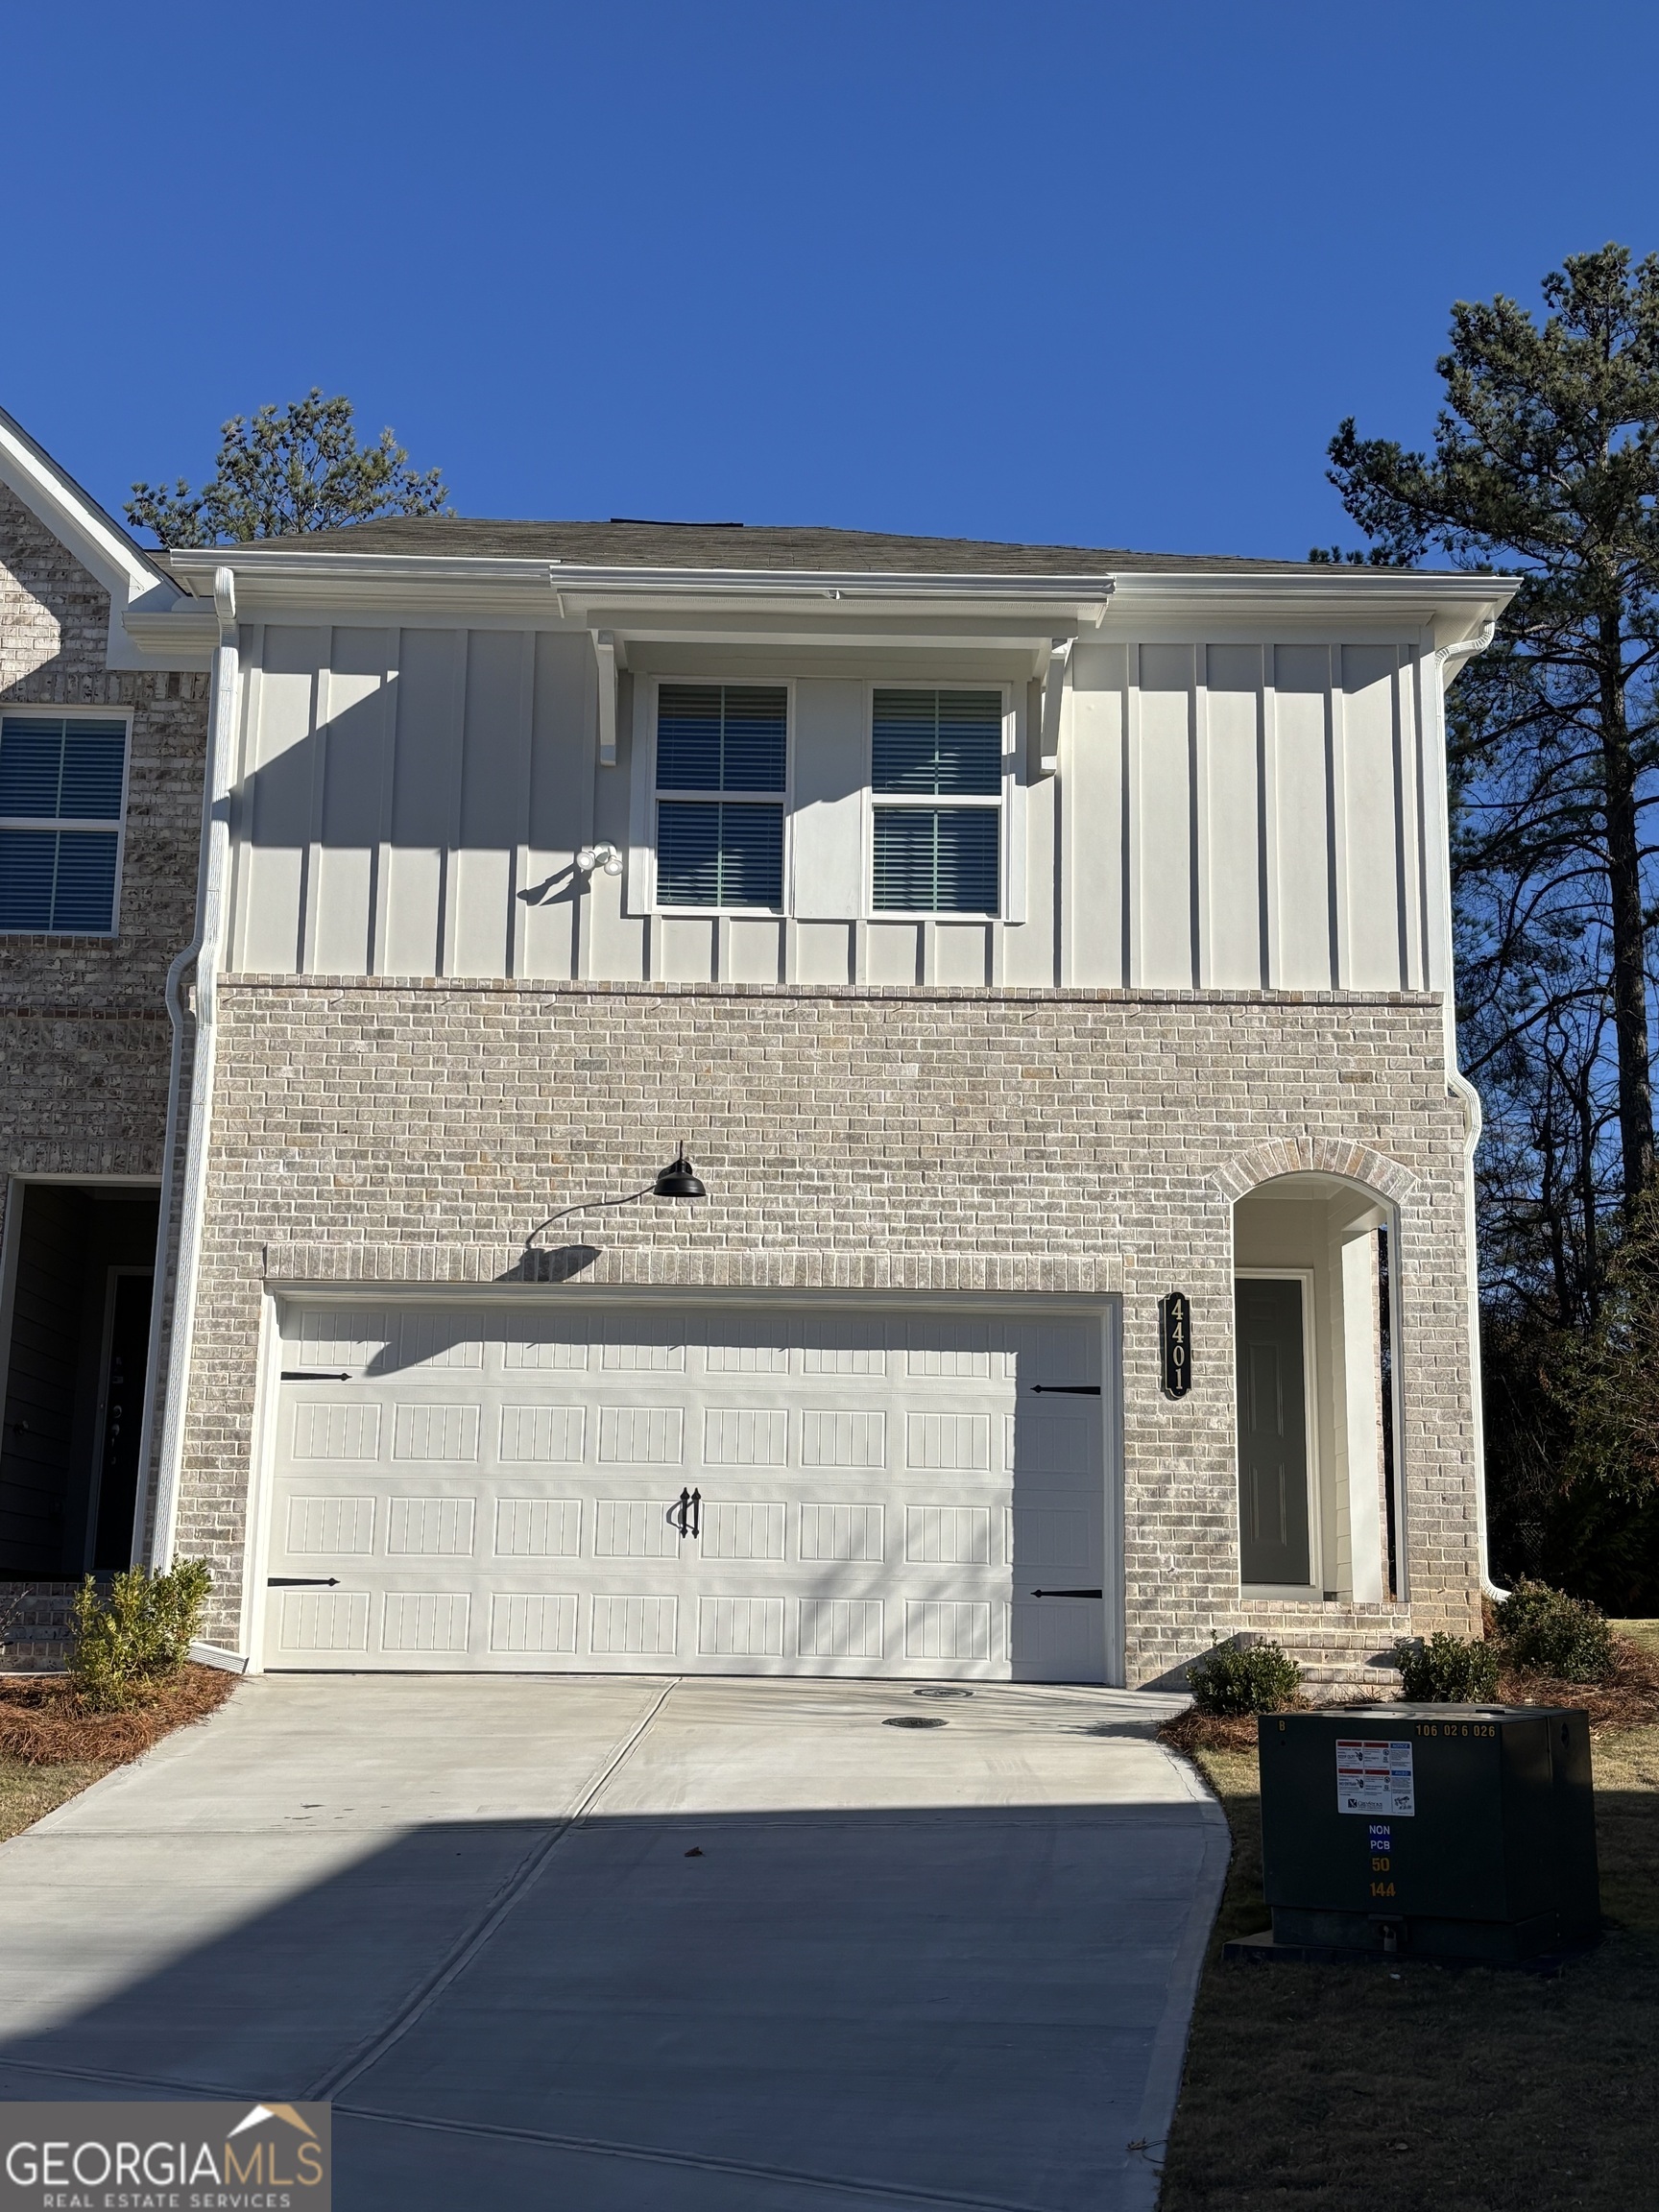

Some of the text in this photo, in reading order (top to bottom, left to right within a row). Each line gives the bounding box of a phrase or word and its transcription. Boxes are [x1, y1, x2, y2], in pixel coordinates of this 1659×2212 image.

[1171, 1298, 1185, 1390] 4401
[1279, 1719, 1286, 1732] B
[1415, 1723, 1438, 1737] 106
[1473, 1724, 1496, 1738] 026
[1368, 1824, 1390, 1835] NON
[1370, 1839, 1391, 1850] PCB
[1372, 1857, 1390, 1872] 50
[1369, 1882, 1396, 1897] 144
